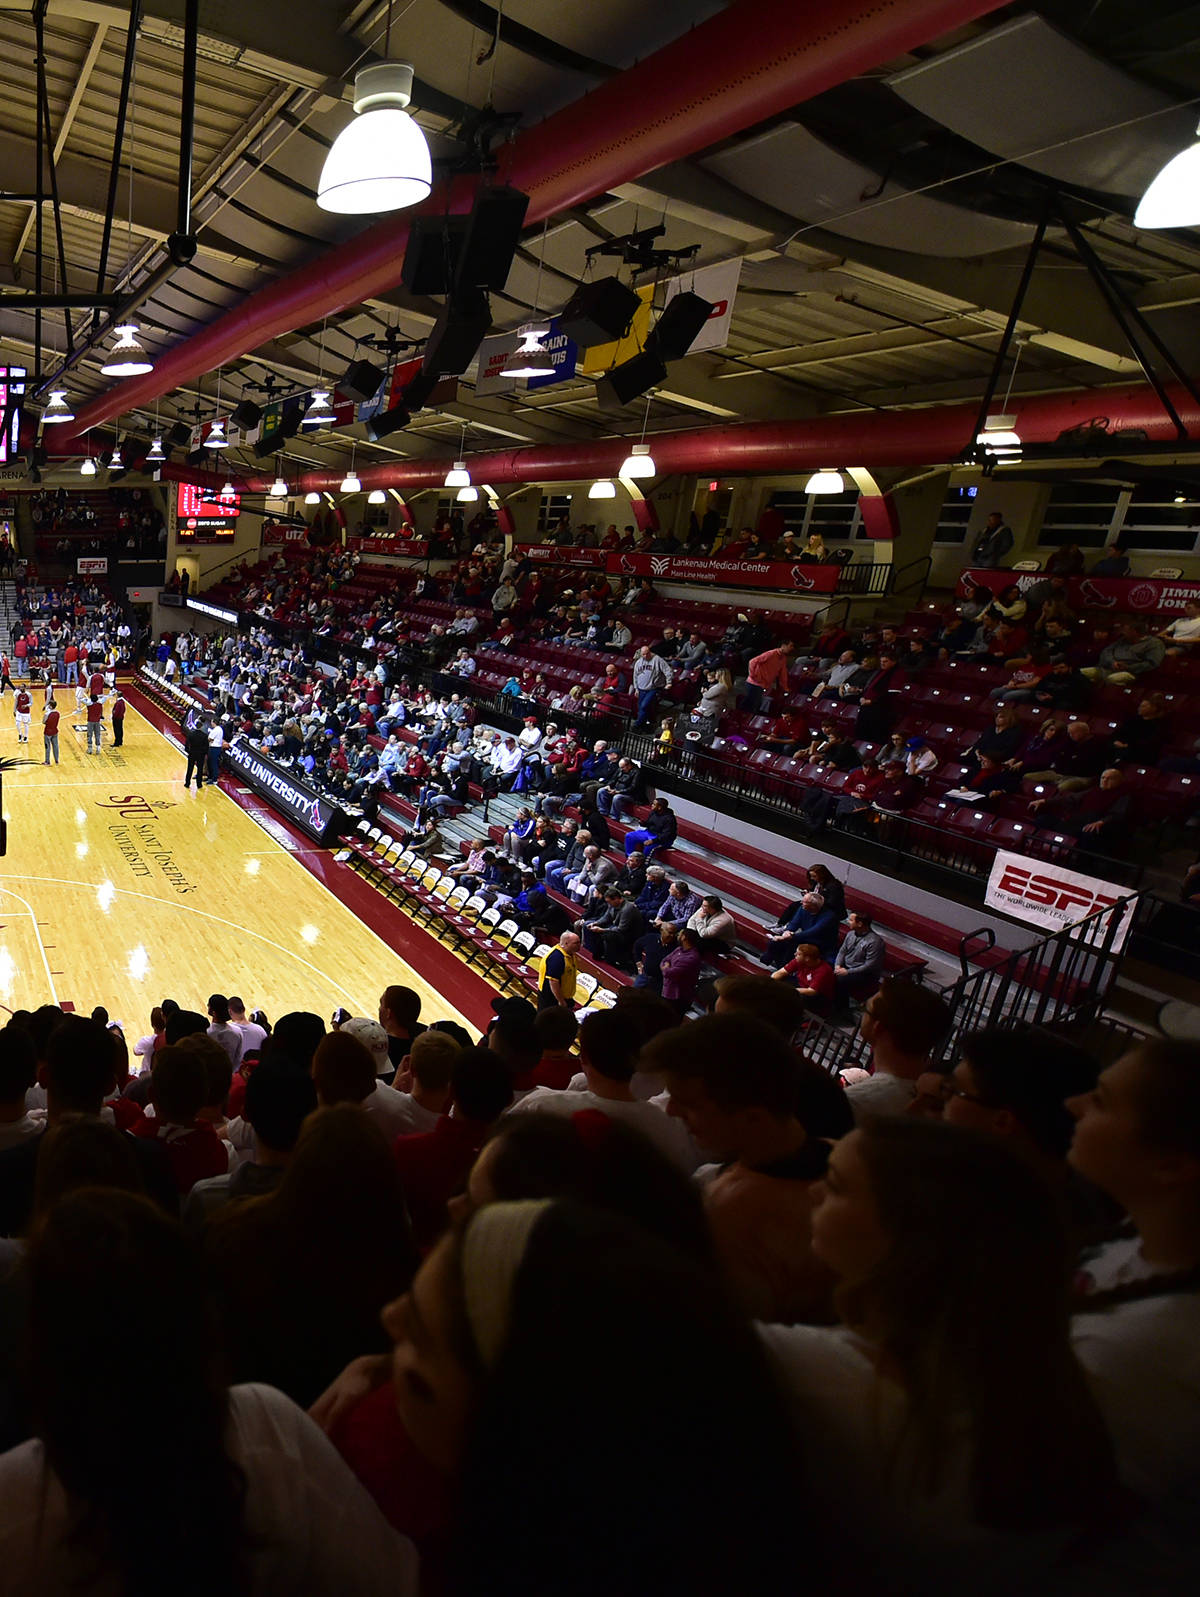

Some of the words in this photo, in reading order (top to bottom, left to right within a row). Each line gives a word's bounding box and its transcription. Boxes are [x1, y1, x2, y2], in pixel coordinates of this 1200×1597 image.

[541, 334, 568, 352] SAINT
[551, 350, 567, 366] UIS
[80, 560, 106, 568] ESPN
[672, 558, 709, 569] Lankenau
[709, 560, 740, 571] Medical
[741, 562, 771, 573] Center
[696, 572, 716, 581] Health
[1157, 599, 1186, 609] JOH
[1160, 587, 1200, 600] JIMM
[250, 760, 311, 814] UNIVERSITY
[94, 795, 159, 820] SJU
[133, 823, 162, 848] SAINT
[108, 824, 153, 878] UNIVERSITY
[145, 850, 197, 894] JOSEPH'S
[998, 865, 1129, 927] ESPN
[994, 891, 1005, 900] THE
[1007, 897, 1048, 915] WORLDWIDE
[1049, 910, 1074, 925] LEADER
